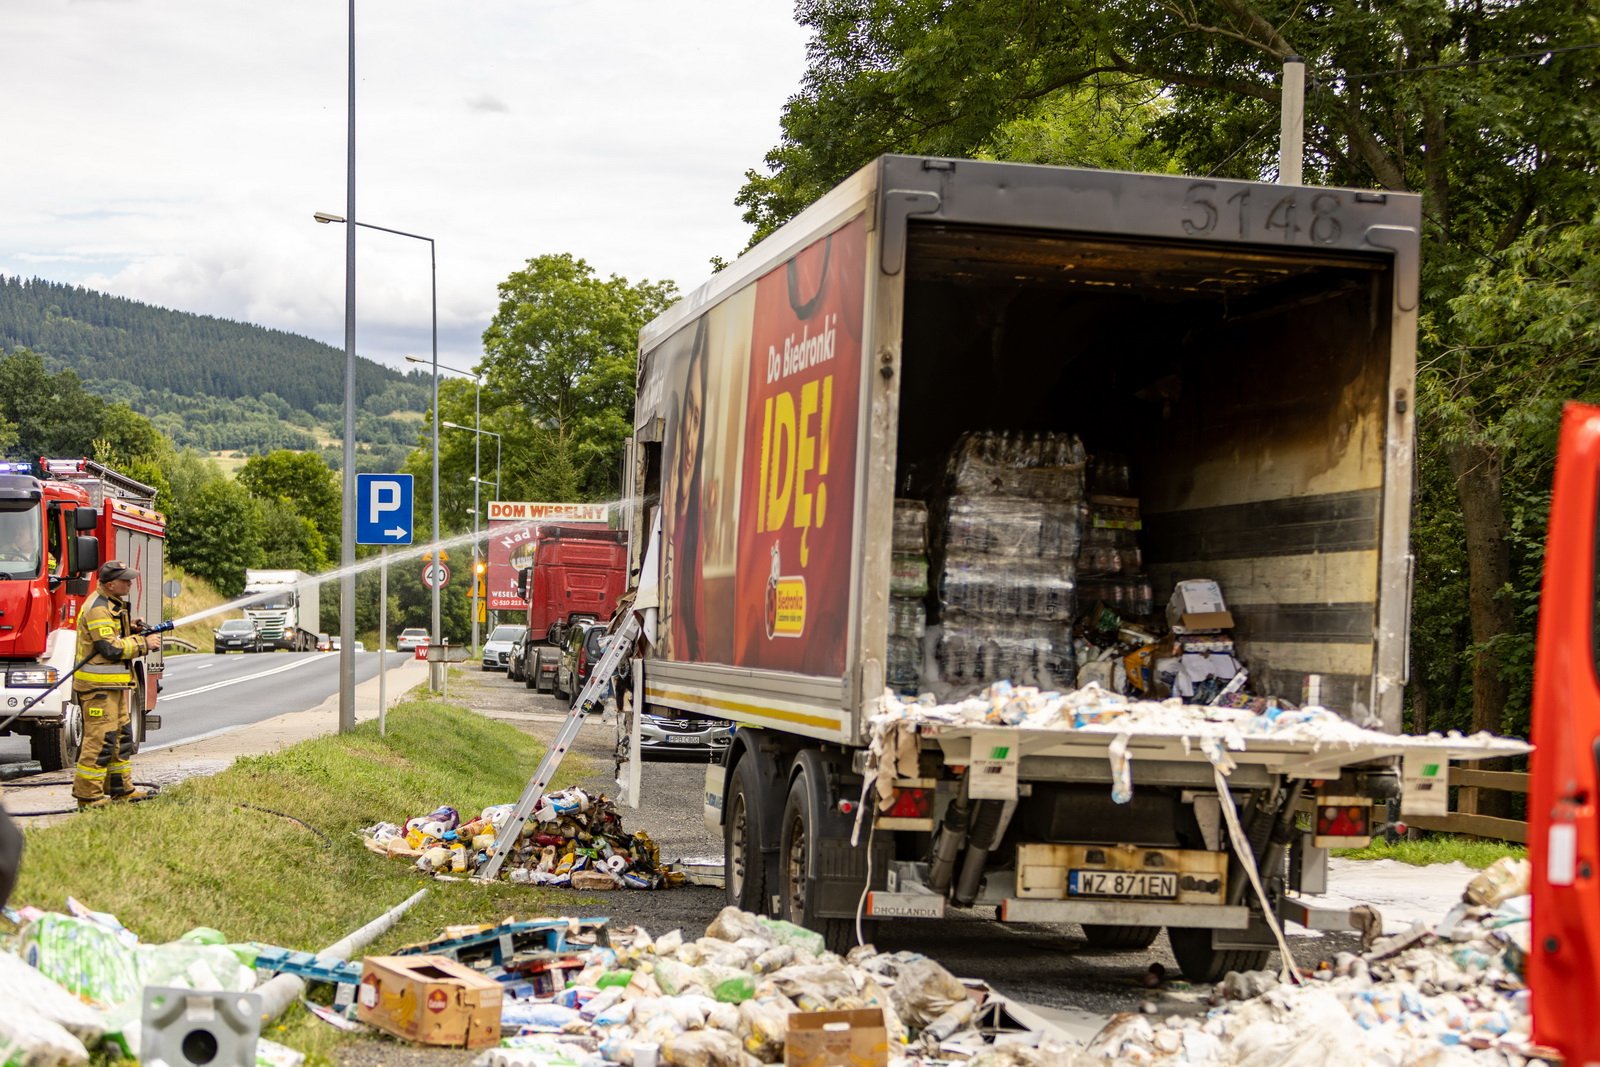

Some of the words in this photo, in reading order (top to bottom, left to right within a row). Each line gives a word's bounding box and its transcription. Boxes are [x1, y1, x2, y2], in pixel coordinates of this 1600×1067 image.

[1181, 182, 1342, 244] 5148
[767, 345, 781, 384] Do
[783, 313, 836, 378] Biedronki
[757, 375, 833, 568] IDĘ!
[370, 481, 401, 523] P
[491, 504, 526, 517] DOM
[530, 504, 605, 520] WESELNY
[501, 527, 531, 549] Nad
[1082, 874, 1106, 893] WZ
[1113, 875, 1173, 897] 871EN
[873, 907, 937, 916] DHOLLANDIA
